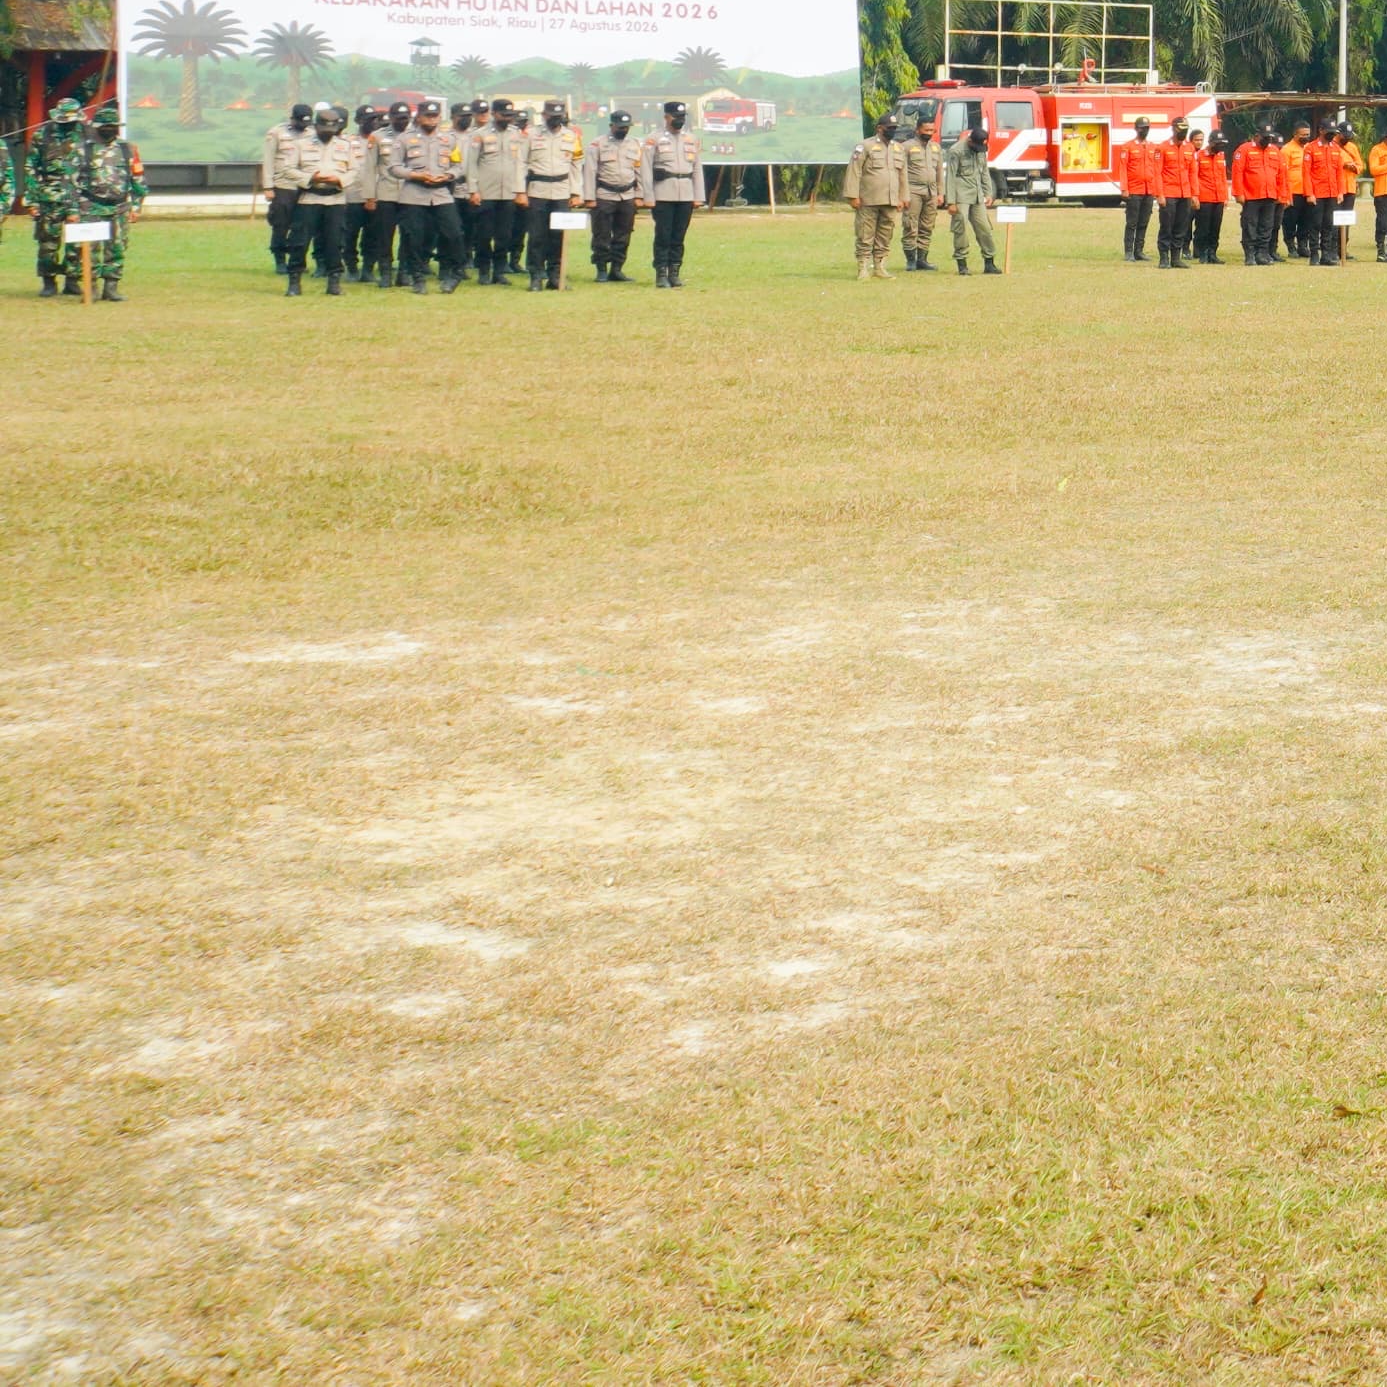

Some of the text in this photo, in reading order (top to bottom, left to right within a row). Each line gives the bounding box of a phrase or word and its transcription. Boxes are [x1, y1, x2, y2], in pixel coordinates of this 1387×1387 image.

[585, 0, 654, 17] LAHAN
[662, 2, 719, 20] 2026
[387, 13, 465, 28] Kabupaten
[470, 15, 502, 28] Siak,
[508, 16, 537, 29] Riau
[549, 18, 565, 30] 27
[570, 19, 622, 33] Agustus
[627, 21, 659, 33] 2026
